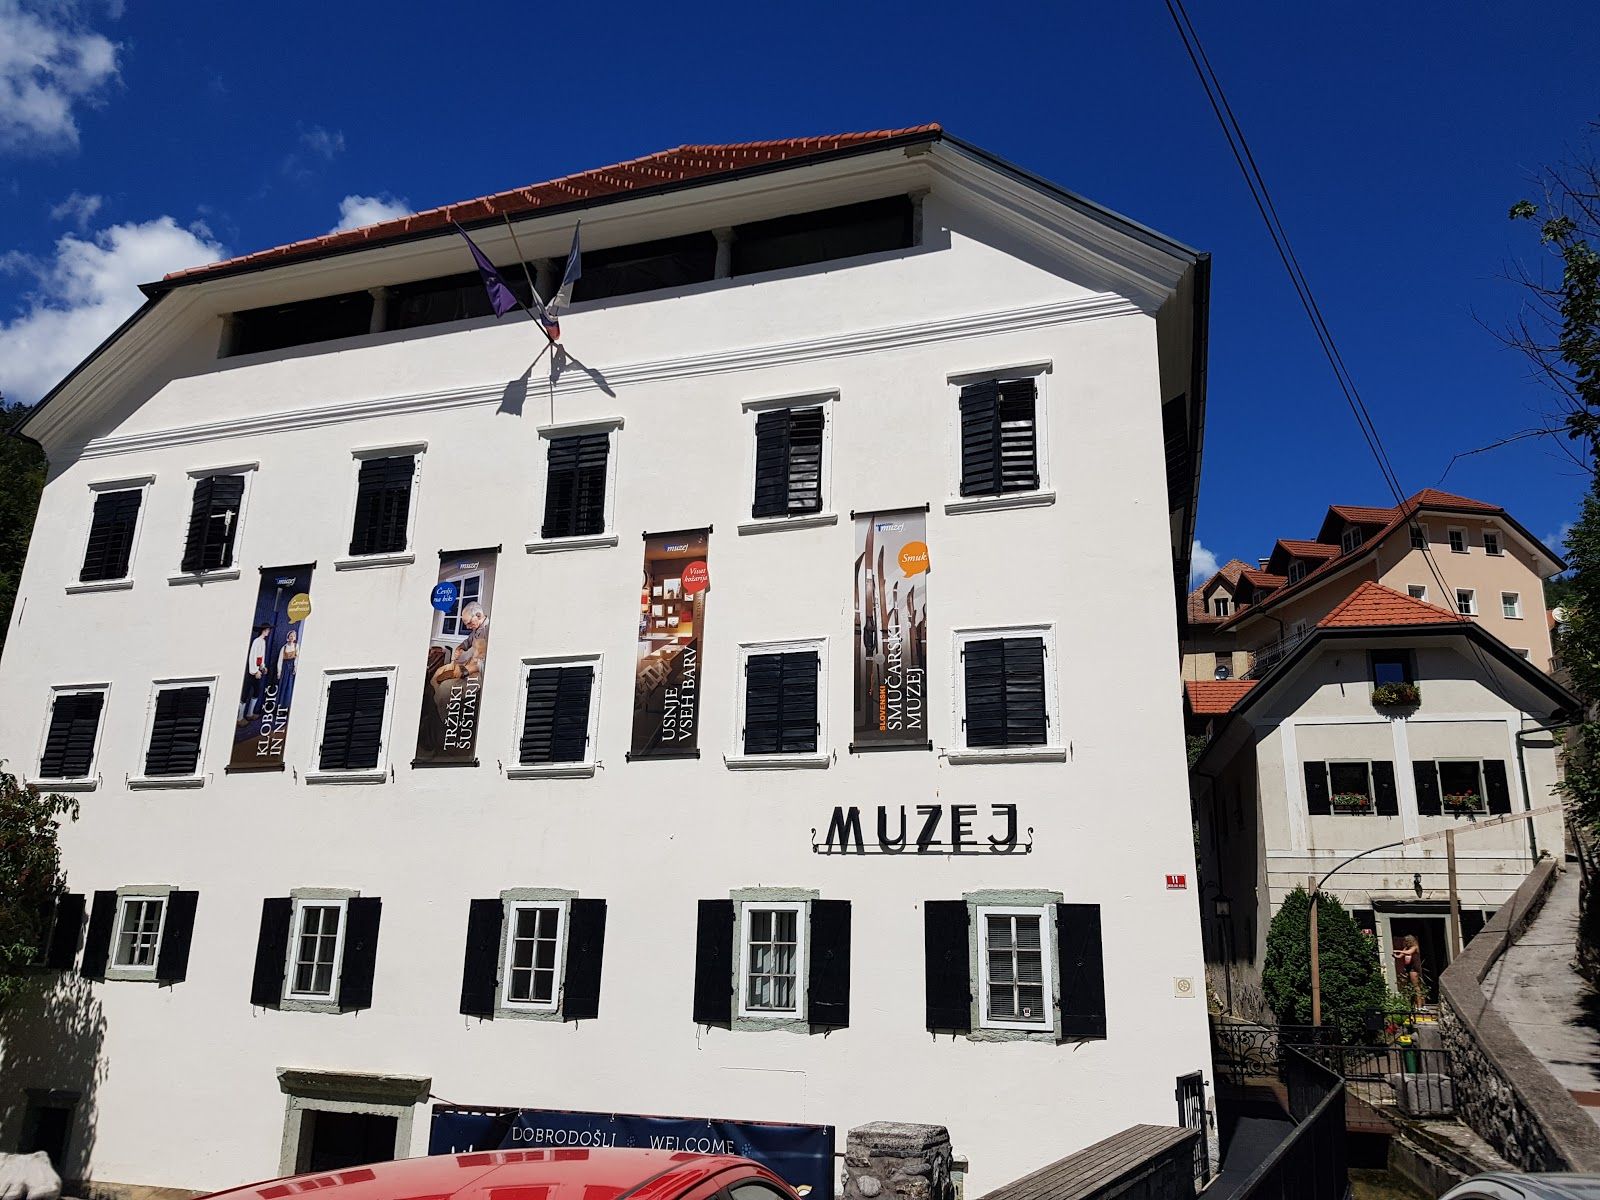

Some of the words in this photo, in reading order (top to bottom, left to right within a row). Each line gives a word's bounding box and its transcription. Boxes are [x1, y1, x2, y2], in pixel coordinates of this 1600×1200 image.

[682, 646, 697, 690] BARV
[884, 624, 902, 731] SMUČARSKI
[256, 684, 279, 756] KLOBČIČ
[273, 704, 289, 734] NIT
[443, 685, 463, 751] TRŽIŠKI
[456, 676, 480, 750] ŠUŠTARJI
[662, 687, 680, 742] USNJE
[679, 694, 695, 742] VSEH
[906, 667, 925, 730] MUZEJ
[270, 738, 284, 756] IN
[825, 803, 1018, 846] MUZEJ
[511, 1126, 617, 1148] DOBRODOŠLI
[650, 1135, 735, 1155] WELCOME
